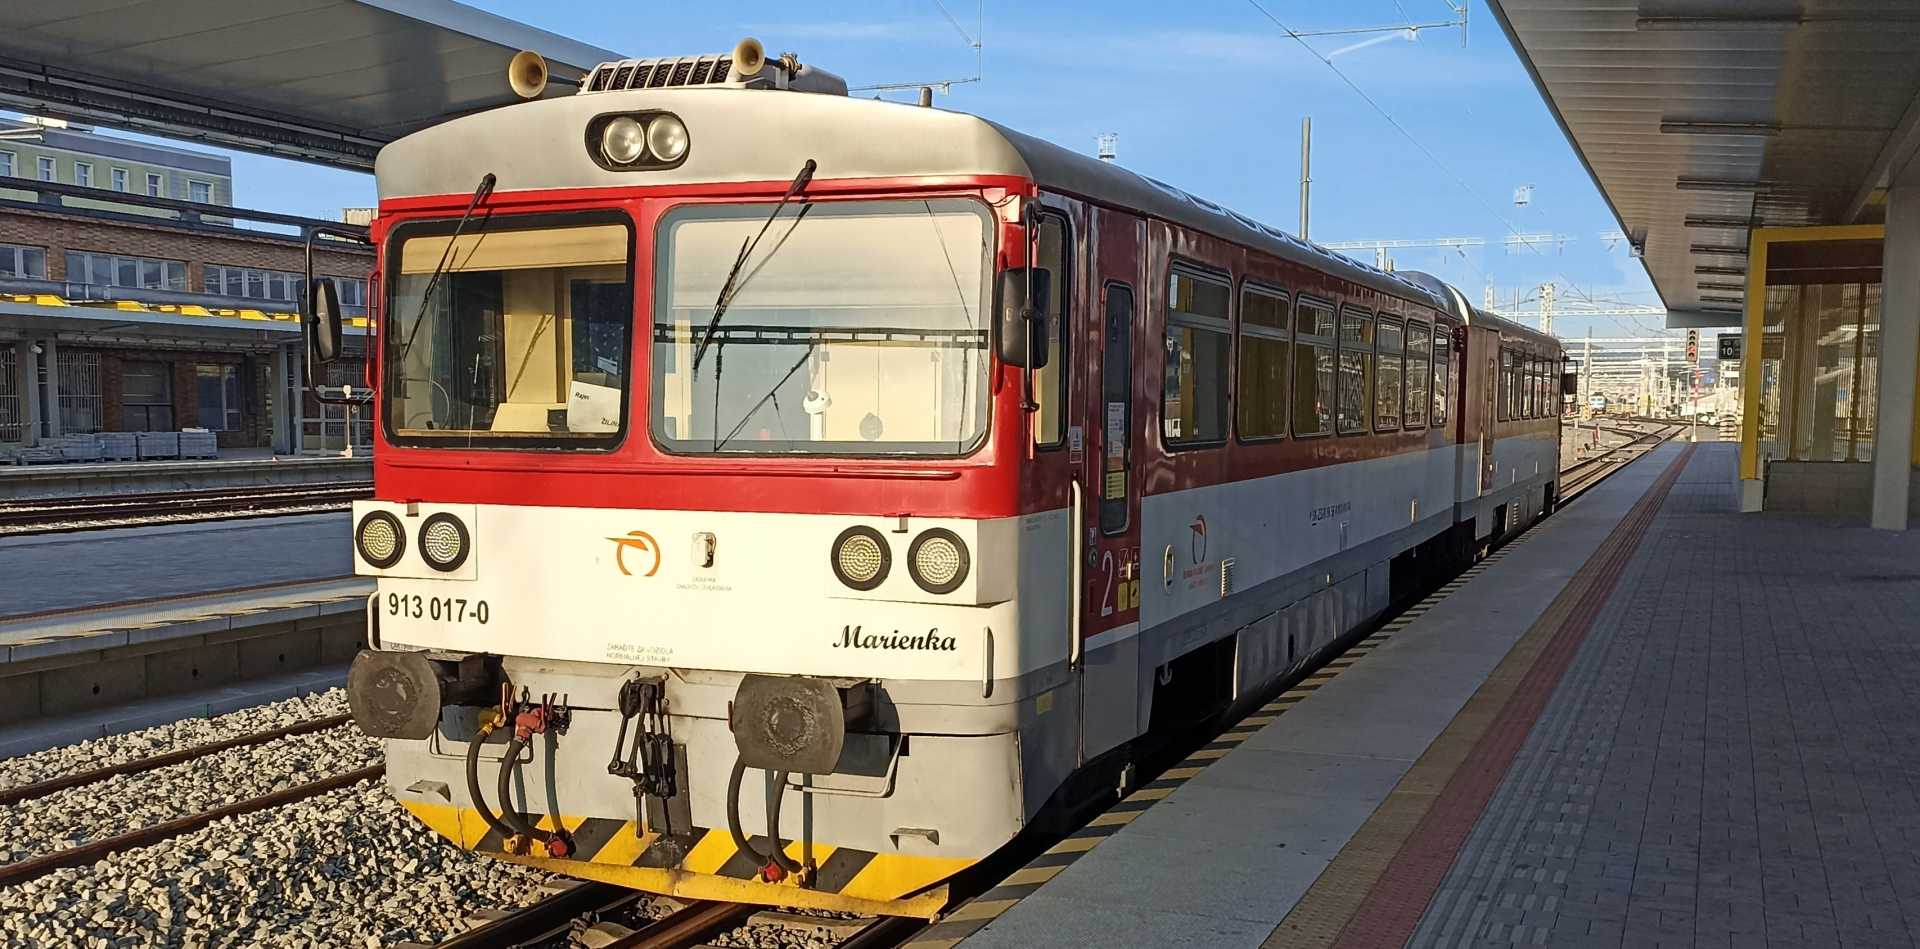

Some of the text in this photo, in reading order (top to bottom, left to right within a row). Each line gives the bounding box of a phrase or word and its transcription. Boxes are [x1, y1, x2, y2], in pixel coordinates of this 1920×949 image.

[1722, 346, 1733, 356] 10
[1101, 550, 1113, 616] 2
[388, 592, 489, 625] 913 017-0
[832, 624, 957, 652] Marienka
